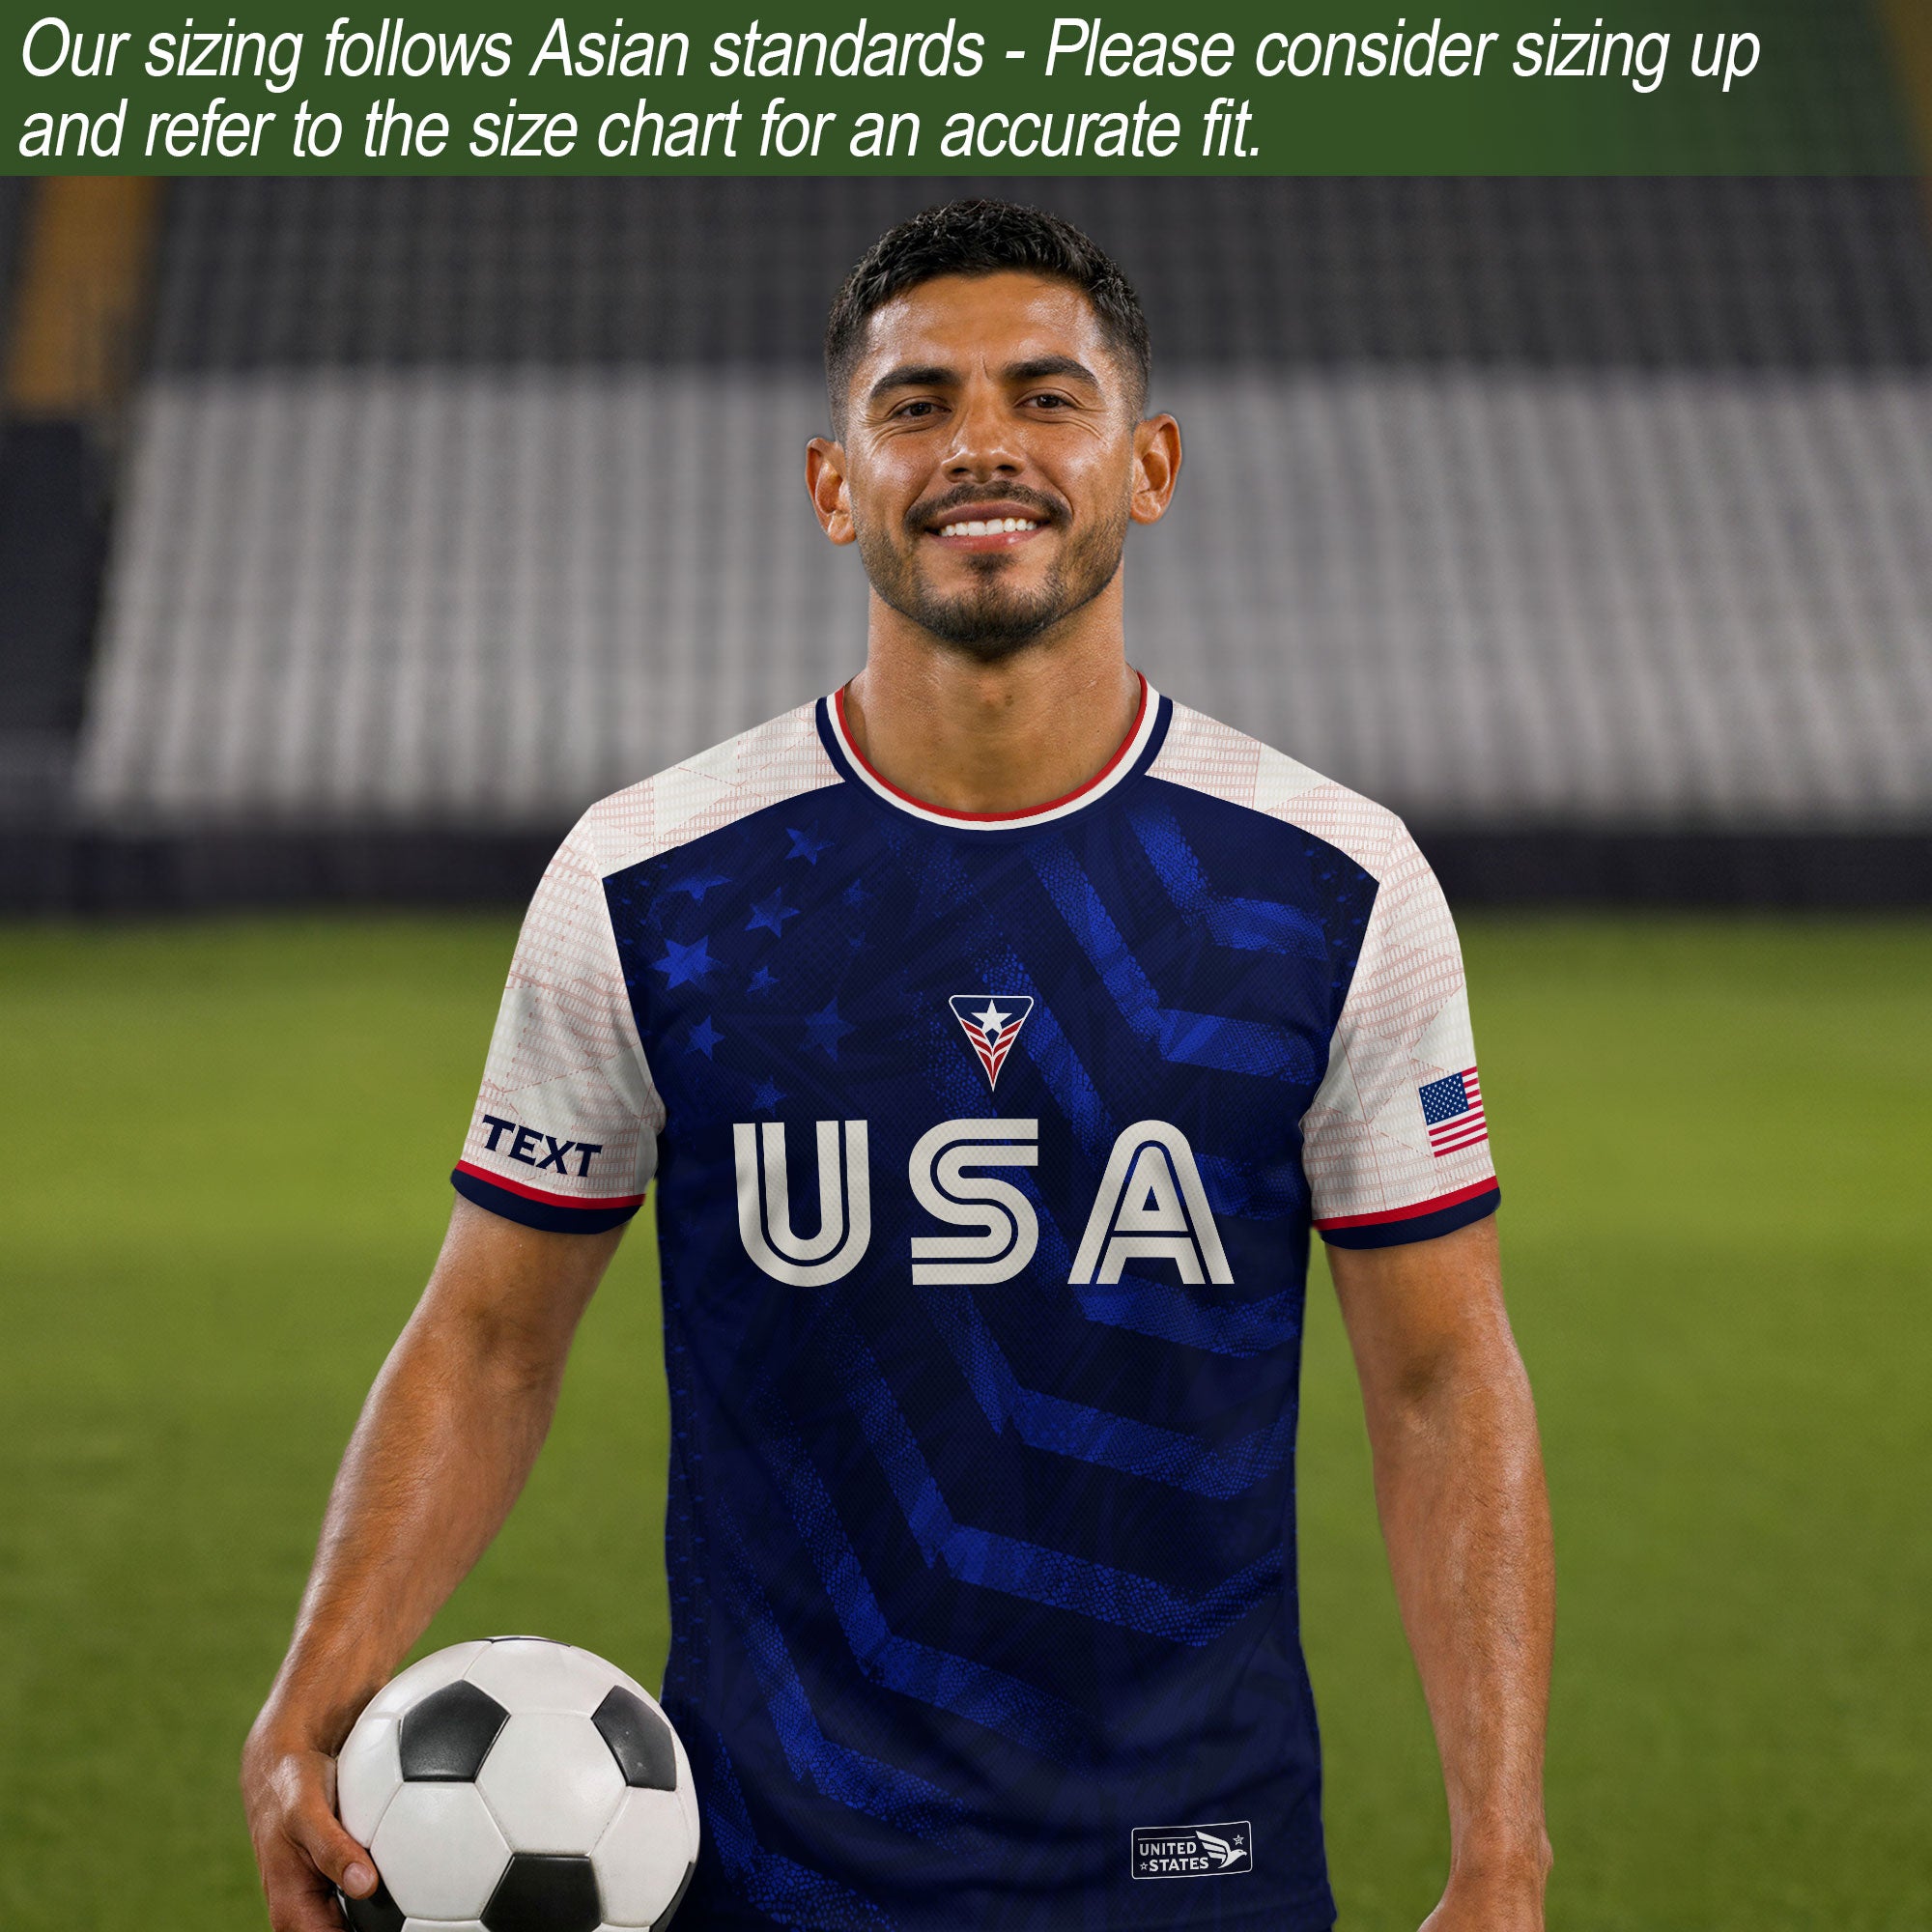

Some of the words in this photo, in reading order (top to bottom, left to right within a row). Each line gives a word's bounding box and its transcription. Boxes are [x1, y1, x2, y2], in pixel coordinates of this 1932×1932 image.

[482, 1114, 603, 1178] TEXT
[732, 1118, 1236, 1288] USA
[1139, 1841, 1197, 1857] UNITED
[1149, 1857, 1209, 1872] STATES
